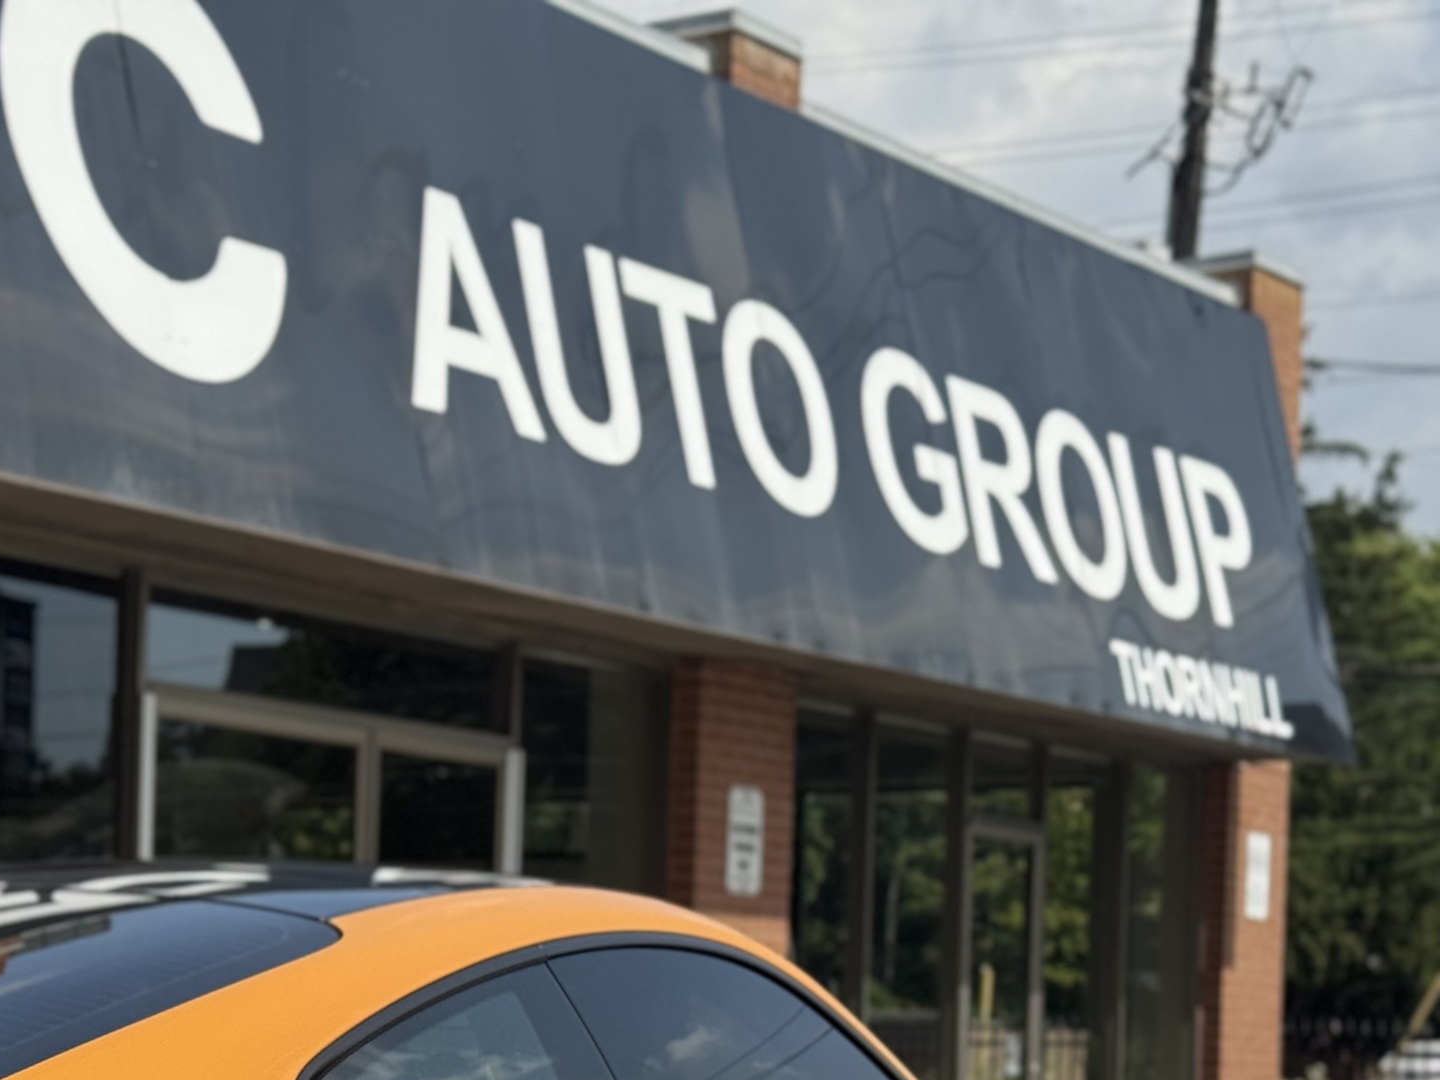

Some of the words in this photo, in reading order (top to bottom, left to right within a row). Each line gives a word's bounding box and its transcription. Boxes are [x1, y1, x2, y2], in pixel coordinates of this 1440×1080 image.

[410, 187, 839, 518] AUTO
[860, 347, 1253, 629] GROUP
[1109, 639, 1296, 740] THORNHILL
